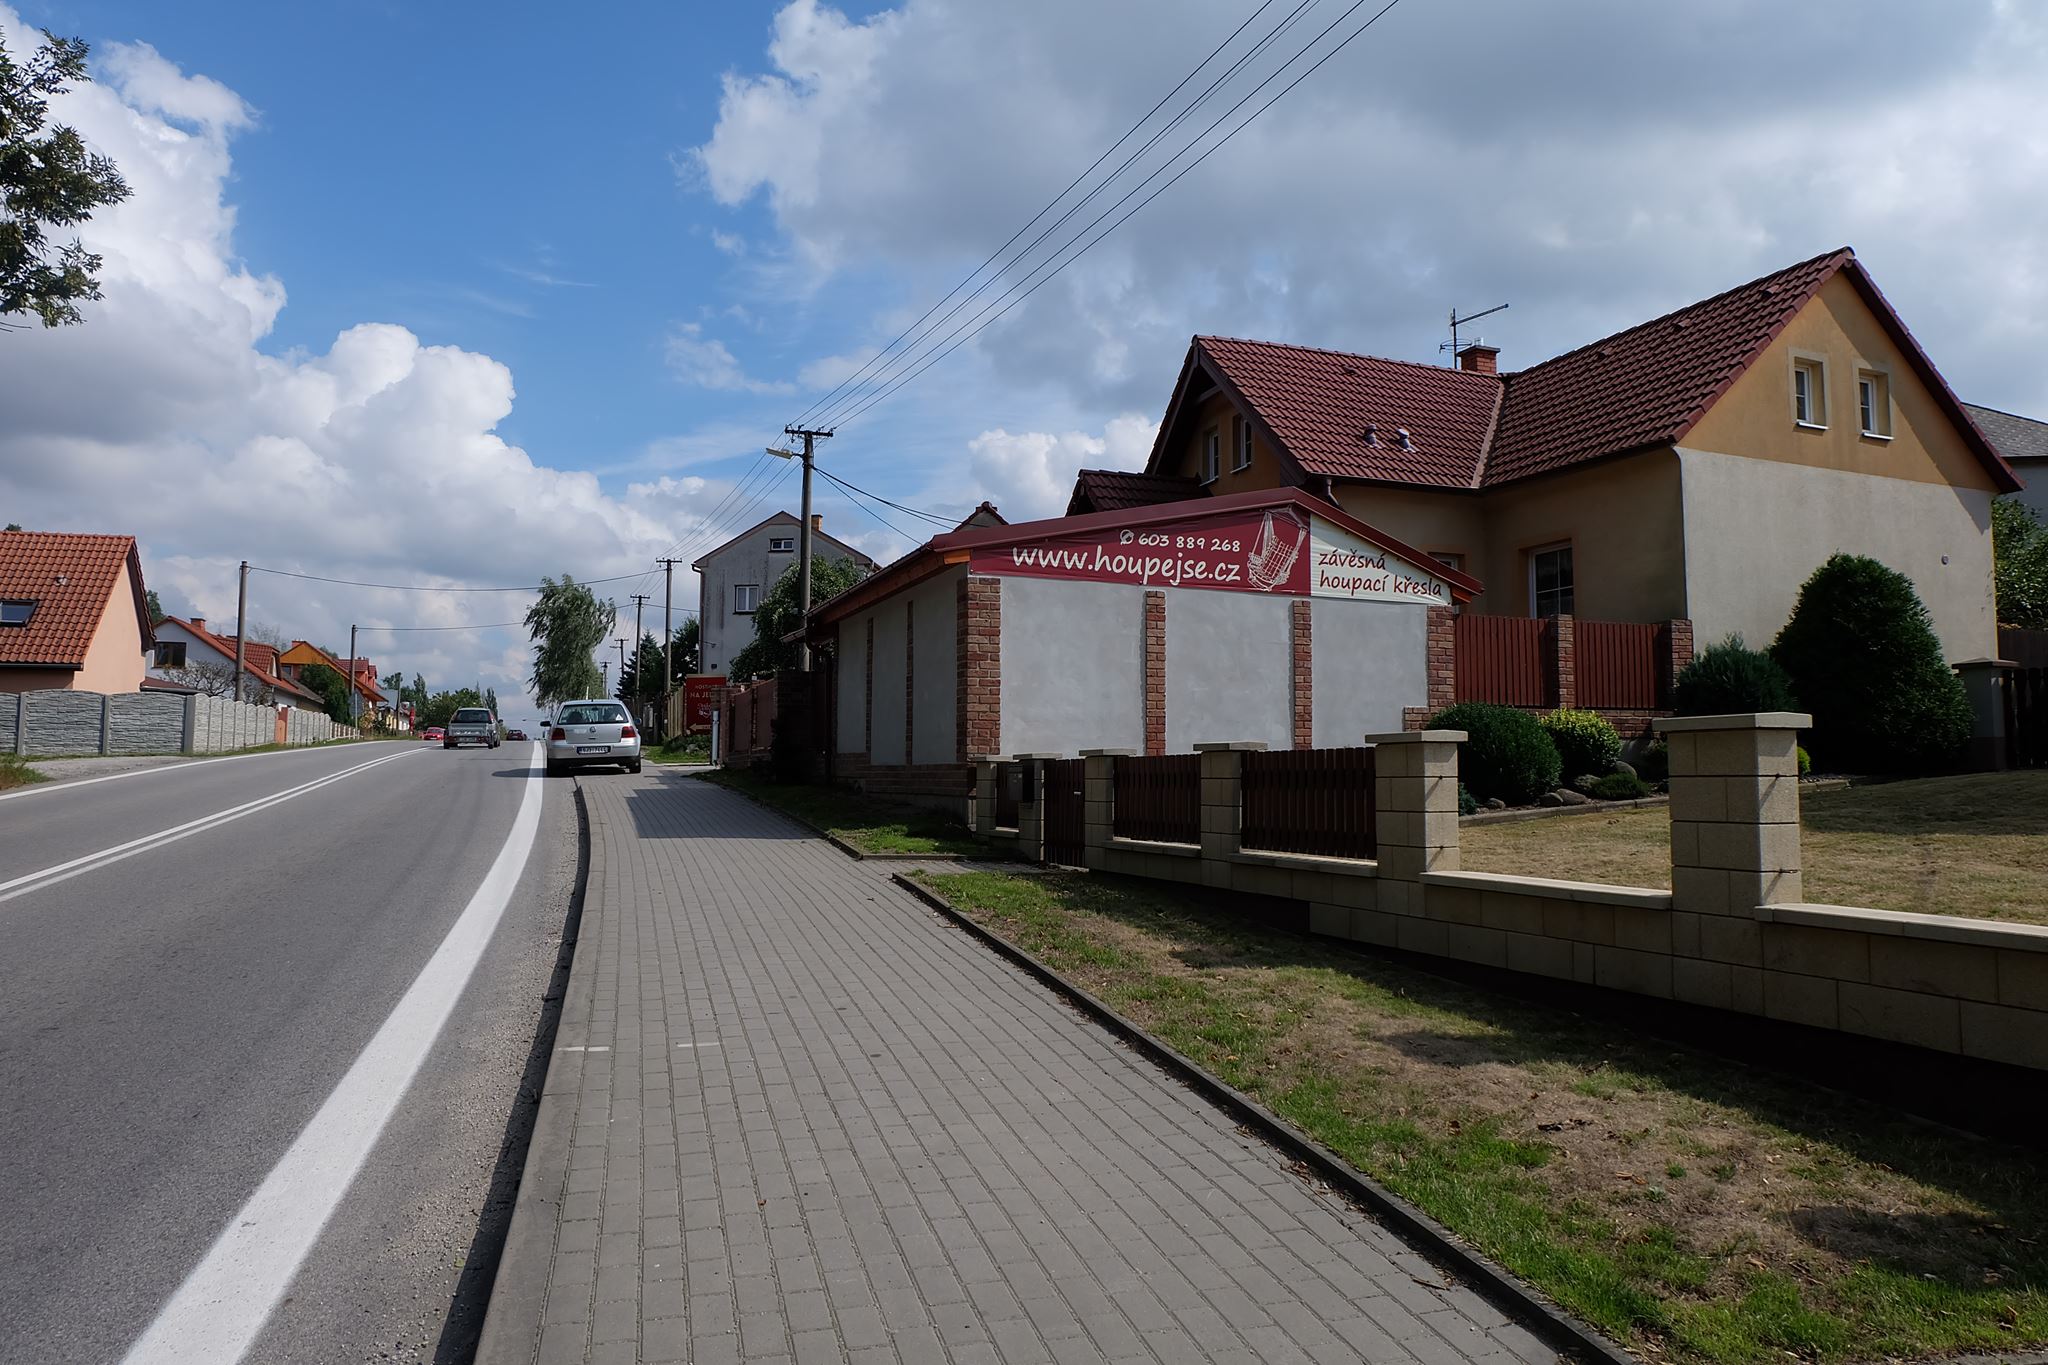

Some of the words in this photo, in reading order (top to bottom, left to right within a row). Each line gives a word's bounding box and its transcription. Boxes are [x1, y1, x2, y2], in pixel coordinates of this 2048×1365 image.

[1138, 533, 1170, 547] 603
[1176, 536, 1206, 550] 889
[1210, 538, 1241, 553] 268
[1012, 545, 1241, 586] www.houpejse.cz
[1318, 548, 1386, 570] závěsná
[1319, 569, 1390, 596] houpací
[1393, 575, 1442, 596] křesla
